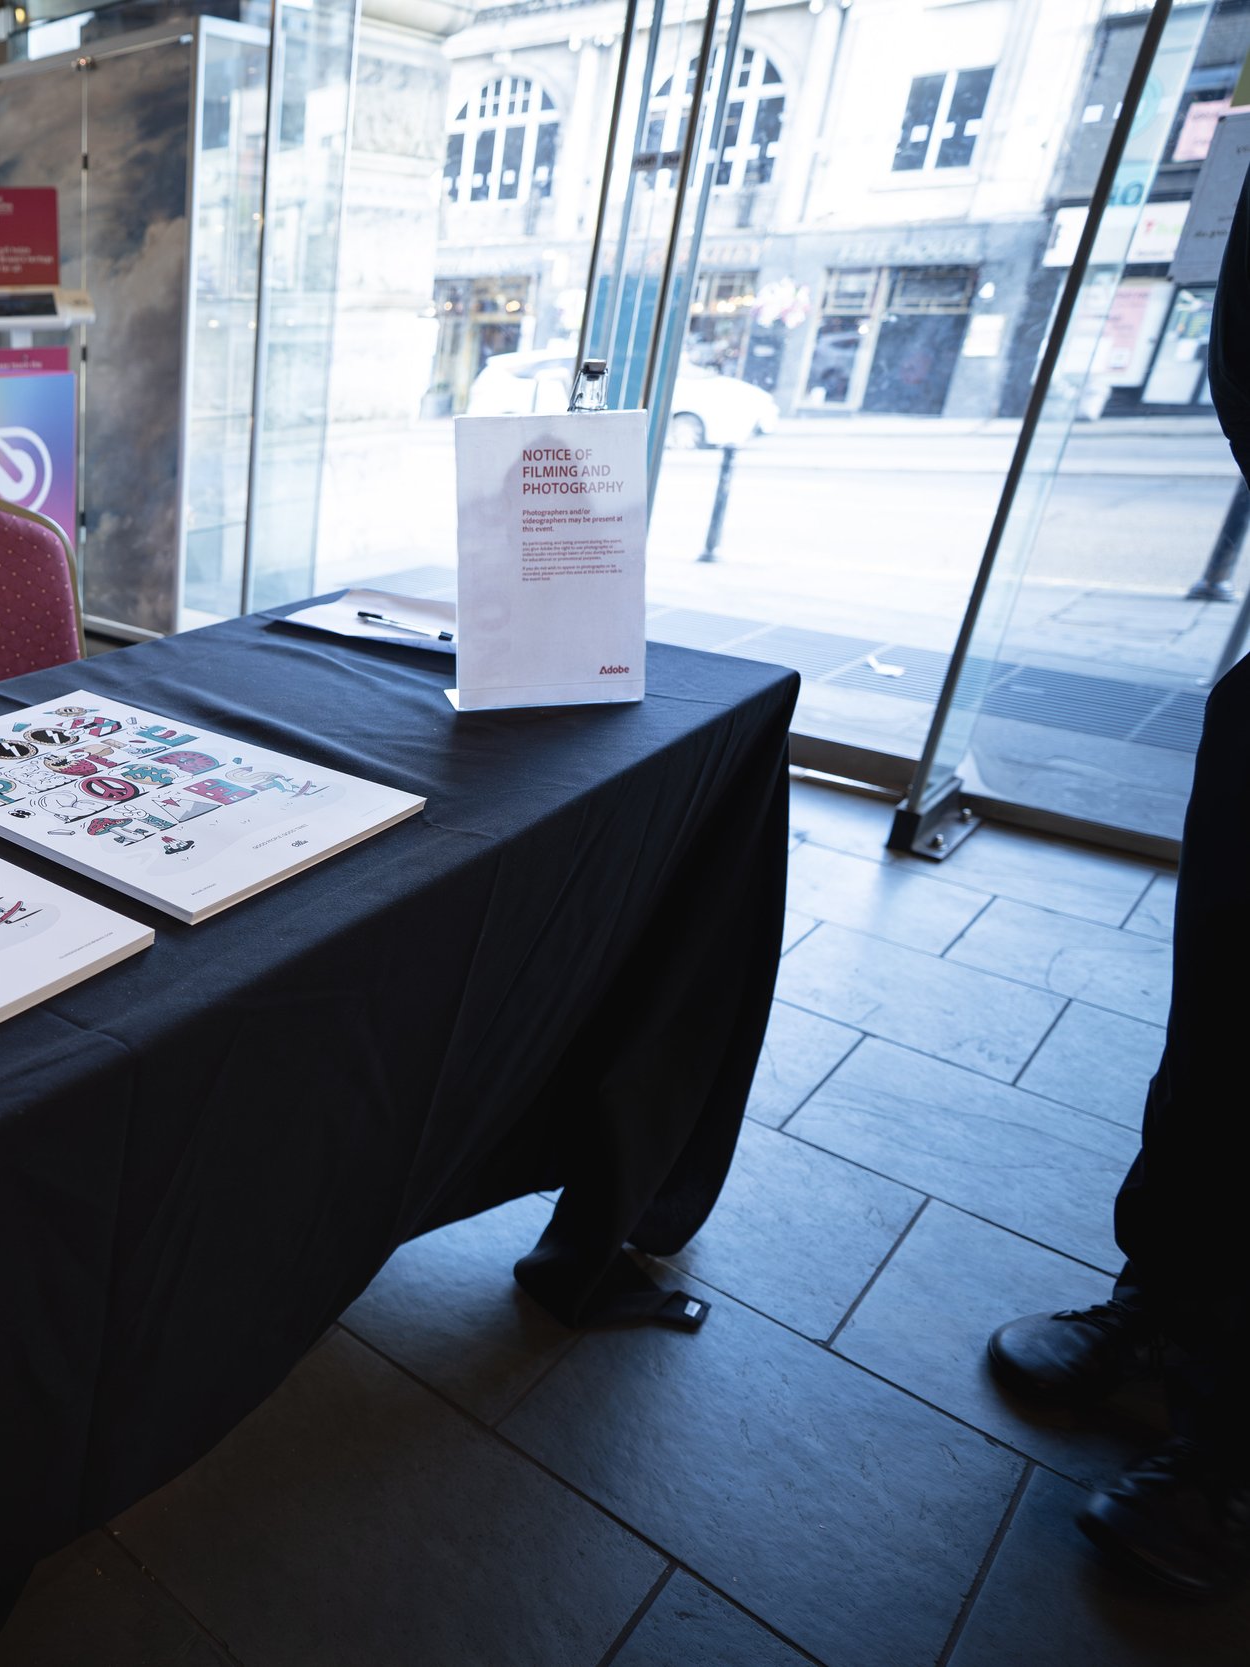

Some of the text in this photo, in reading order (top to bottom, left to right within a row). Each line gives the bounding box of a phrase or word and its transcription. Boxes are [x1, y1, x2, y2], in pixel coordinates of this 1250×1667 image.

[523, 449, 592, 461] NOTICE OF
[523, 465, 611, 478] FILMING AND
[523, 481, 624, 495] PHOTOGRAPHY
[522, 509, 568, 517] Photographers
[522, 517, 567, 525] videographers
[599, 664, 630, 675] Adobe
